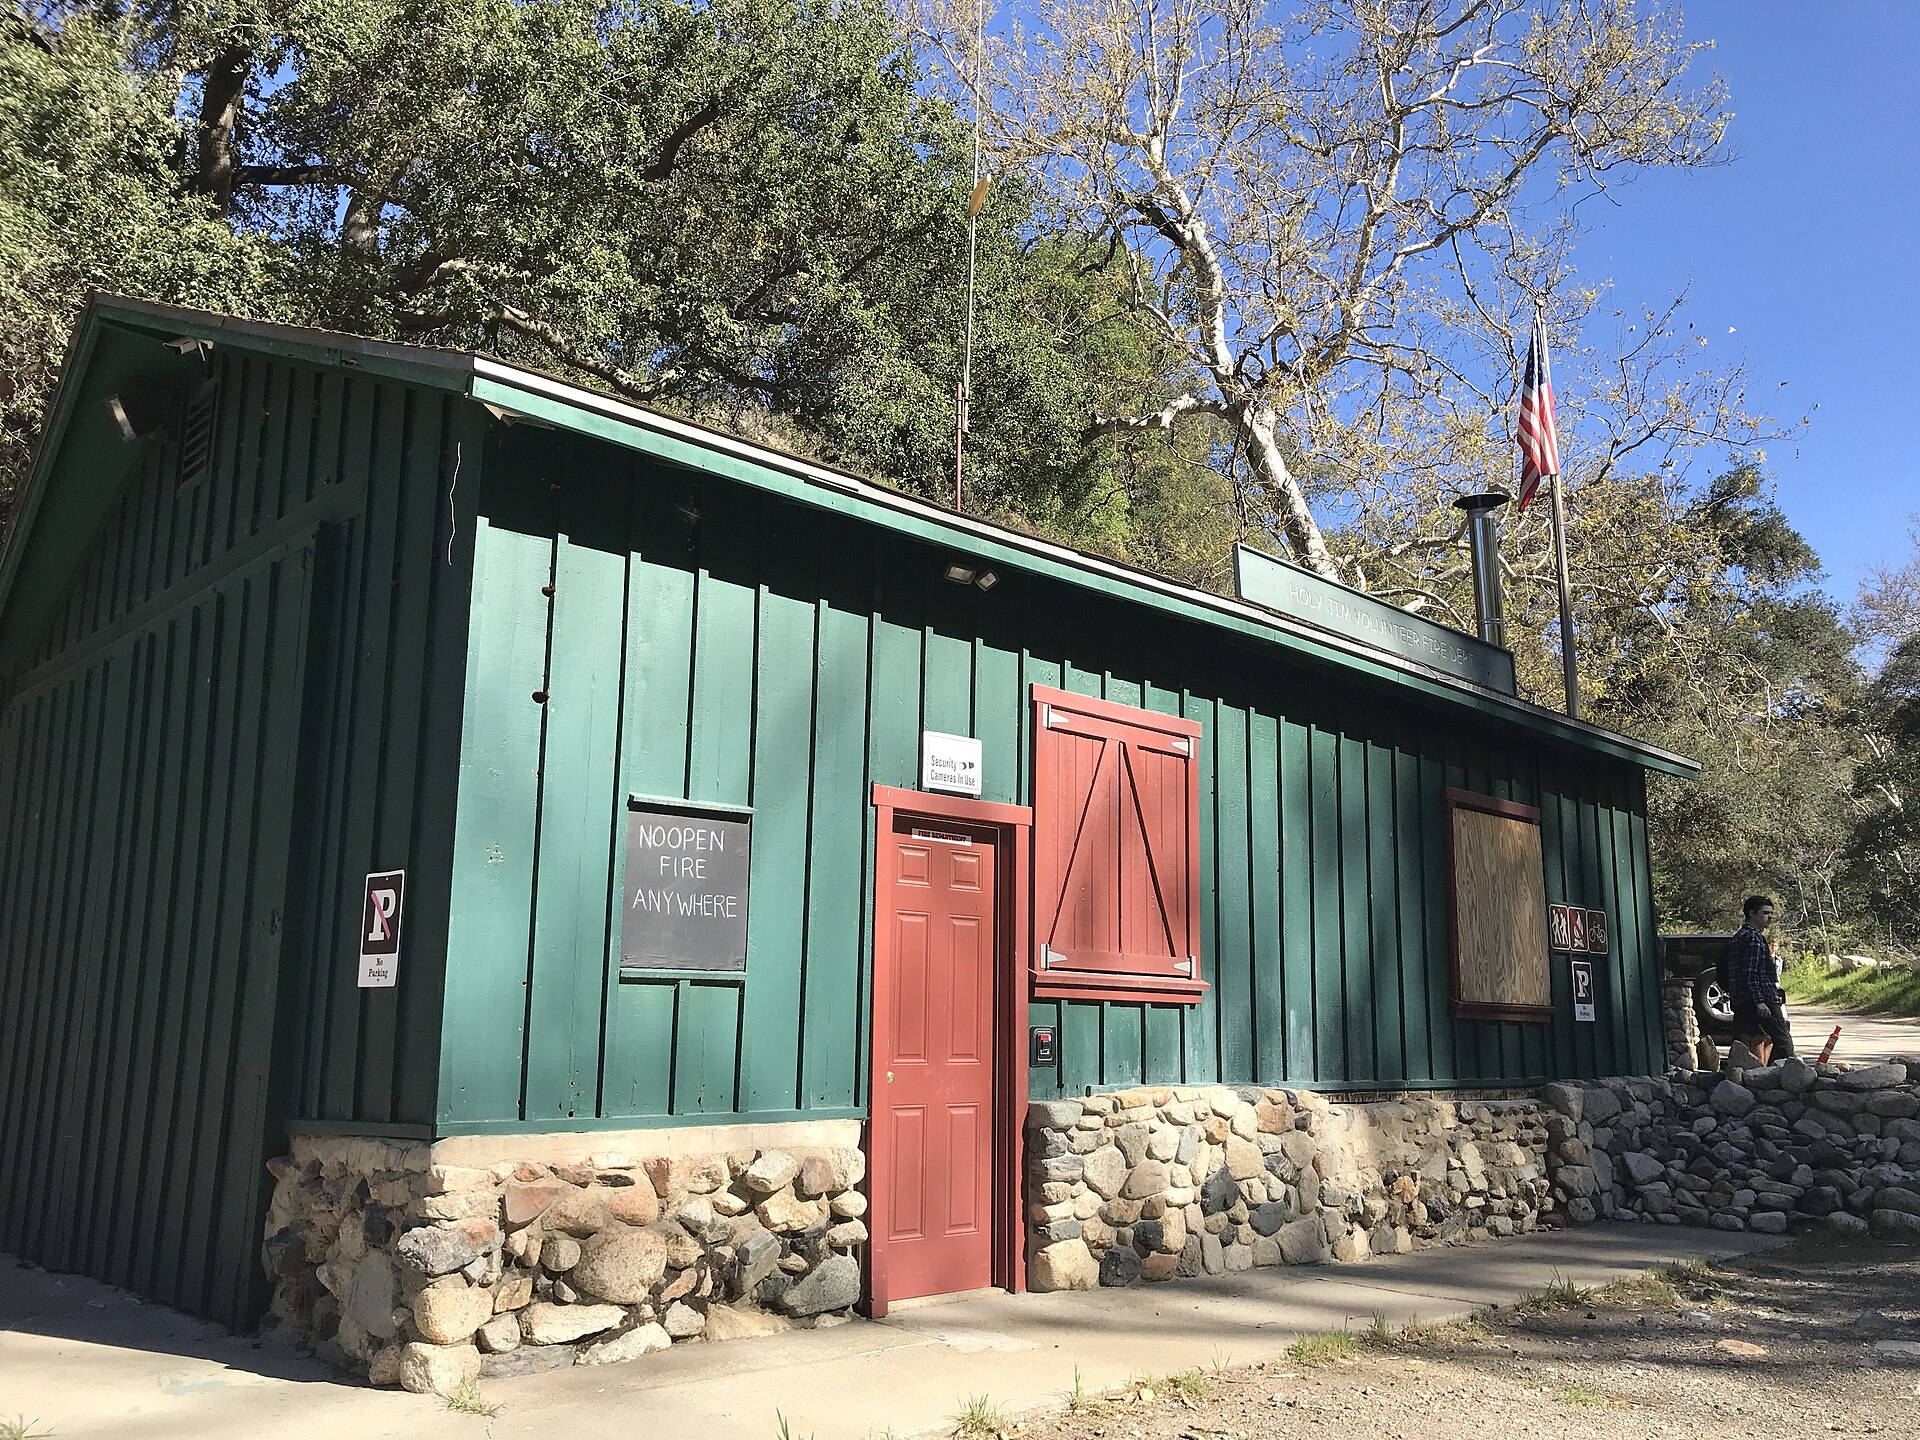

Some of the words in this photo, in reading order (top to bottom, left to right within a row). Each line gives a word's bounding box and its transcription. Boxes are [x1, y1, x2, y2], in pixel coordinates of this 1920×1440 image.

[1289, 582, 1323, 610] HOLY
[1327, 597, 1352, 622] JIM
[1354, 608, 1420, 648] VOLUNTEER
[1422, 634, 1448, 659] FIRE
[930, 755, 958, 771] Security
[930, 769, 957, 784] Cameras
[957, 773, 964, 785] In
[964, 775, 975, 787] Use
[660, 855, 707, 879] FIRE
[632, 888, 738, 918] ANYWHERE
[368, 888, 396, 942] P
[376, 957, 383, 966] No
[368, 968, 389, 979] Parking
